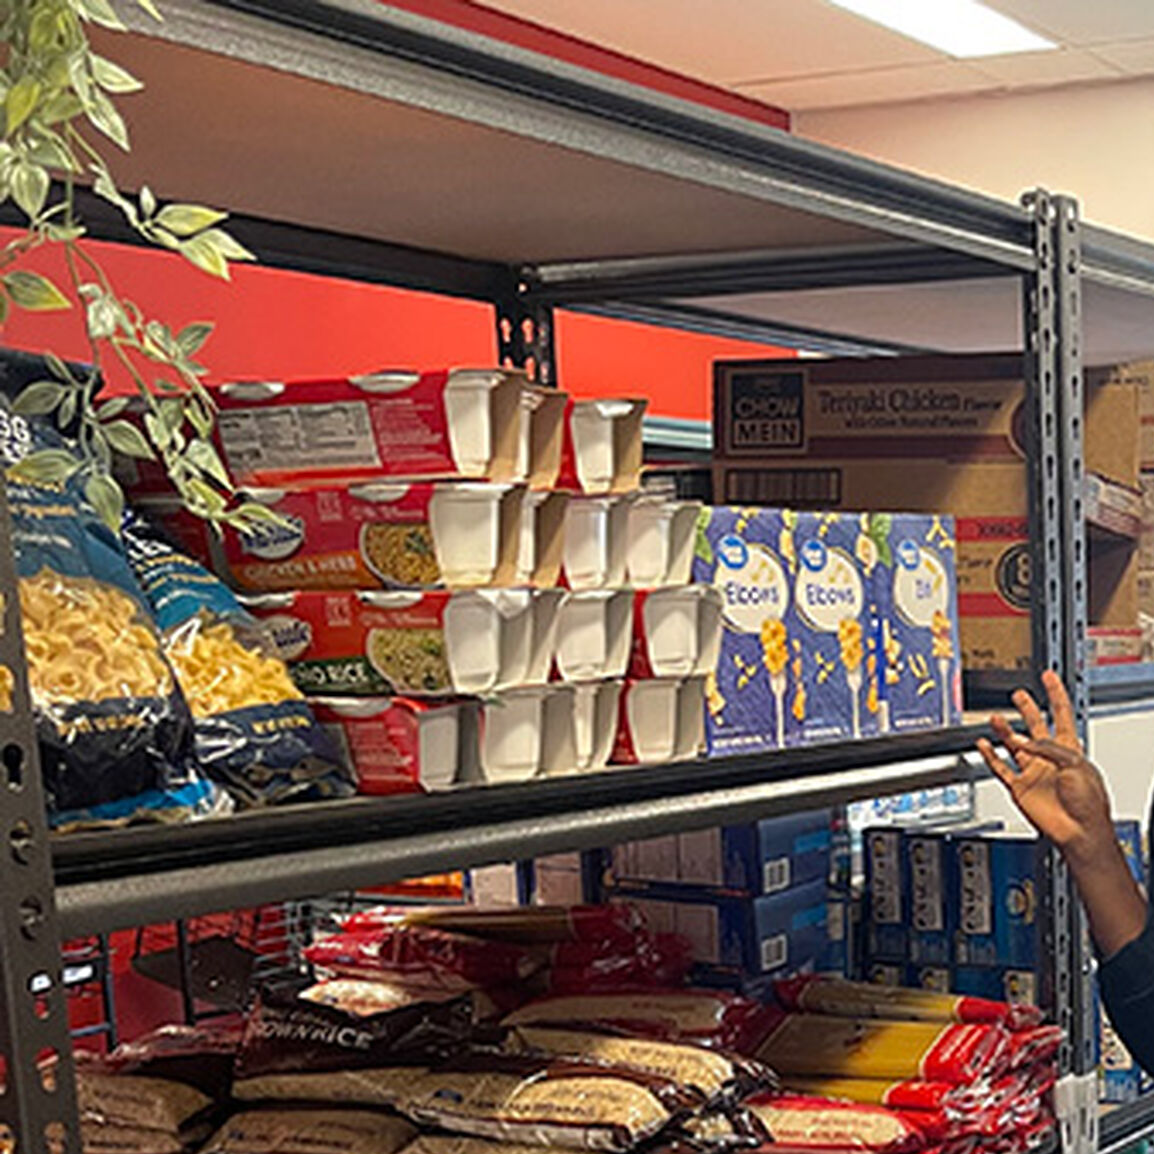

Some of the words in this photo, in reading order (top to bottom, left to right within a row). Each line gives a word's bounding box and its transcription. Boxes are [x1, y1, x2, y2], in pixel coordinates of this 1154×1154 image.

[735, 397, 799, 417] CHOW
[818, 391, 885, 413] Teriyaki
[887, 389, 959, 413] Chicken
[737, 422, 796, 442] MEIN
[1017, 552, 1033, 585] 8
[327, 662, 369, 683] RICE
